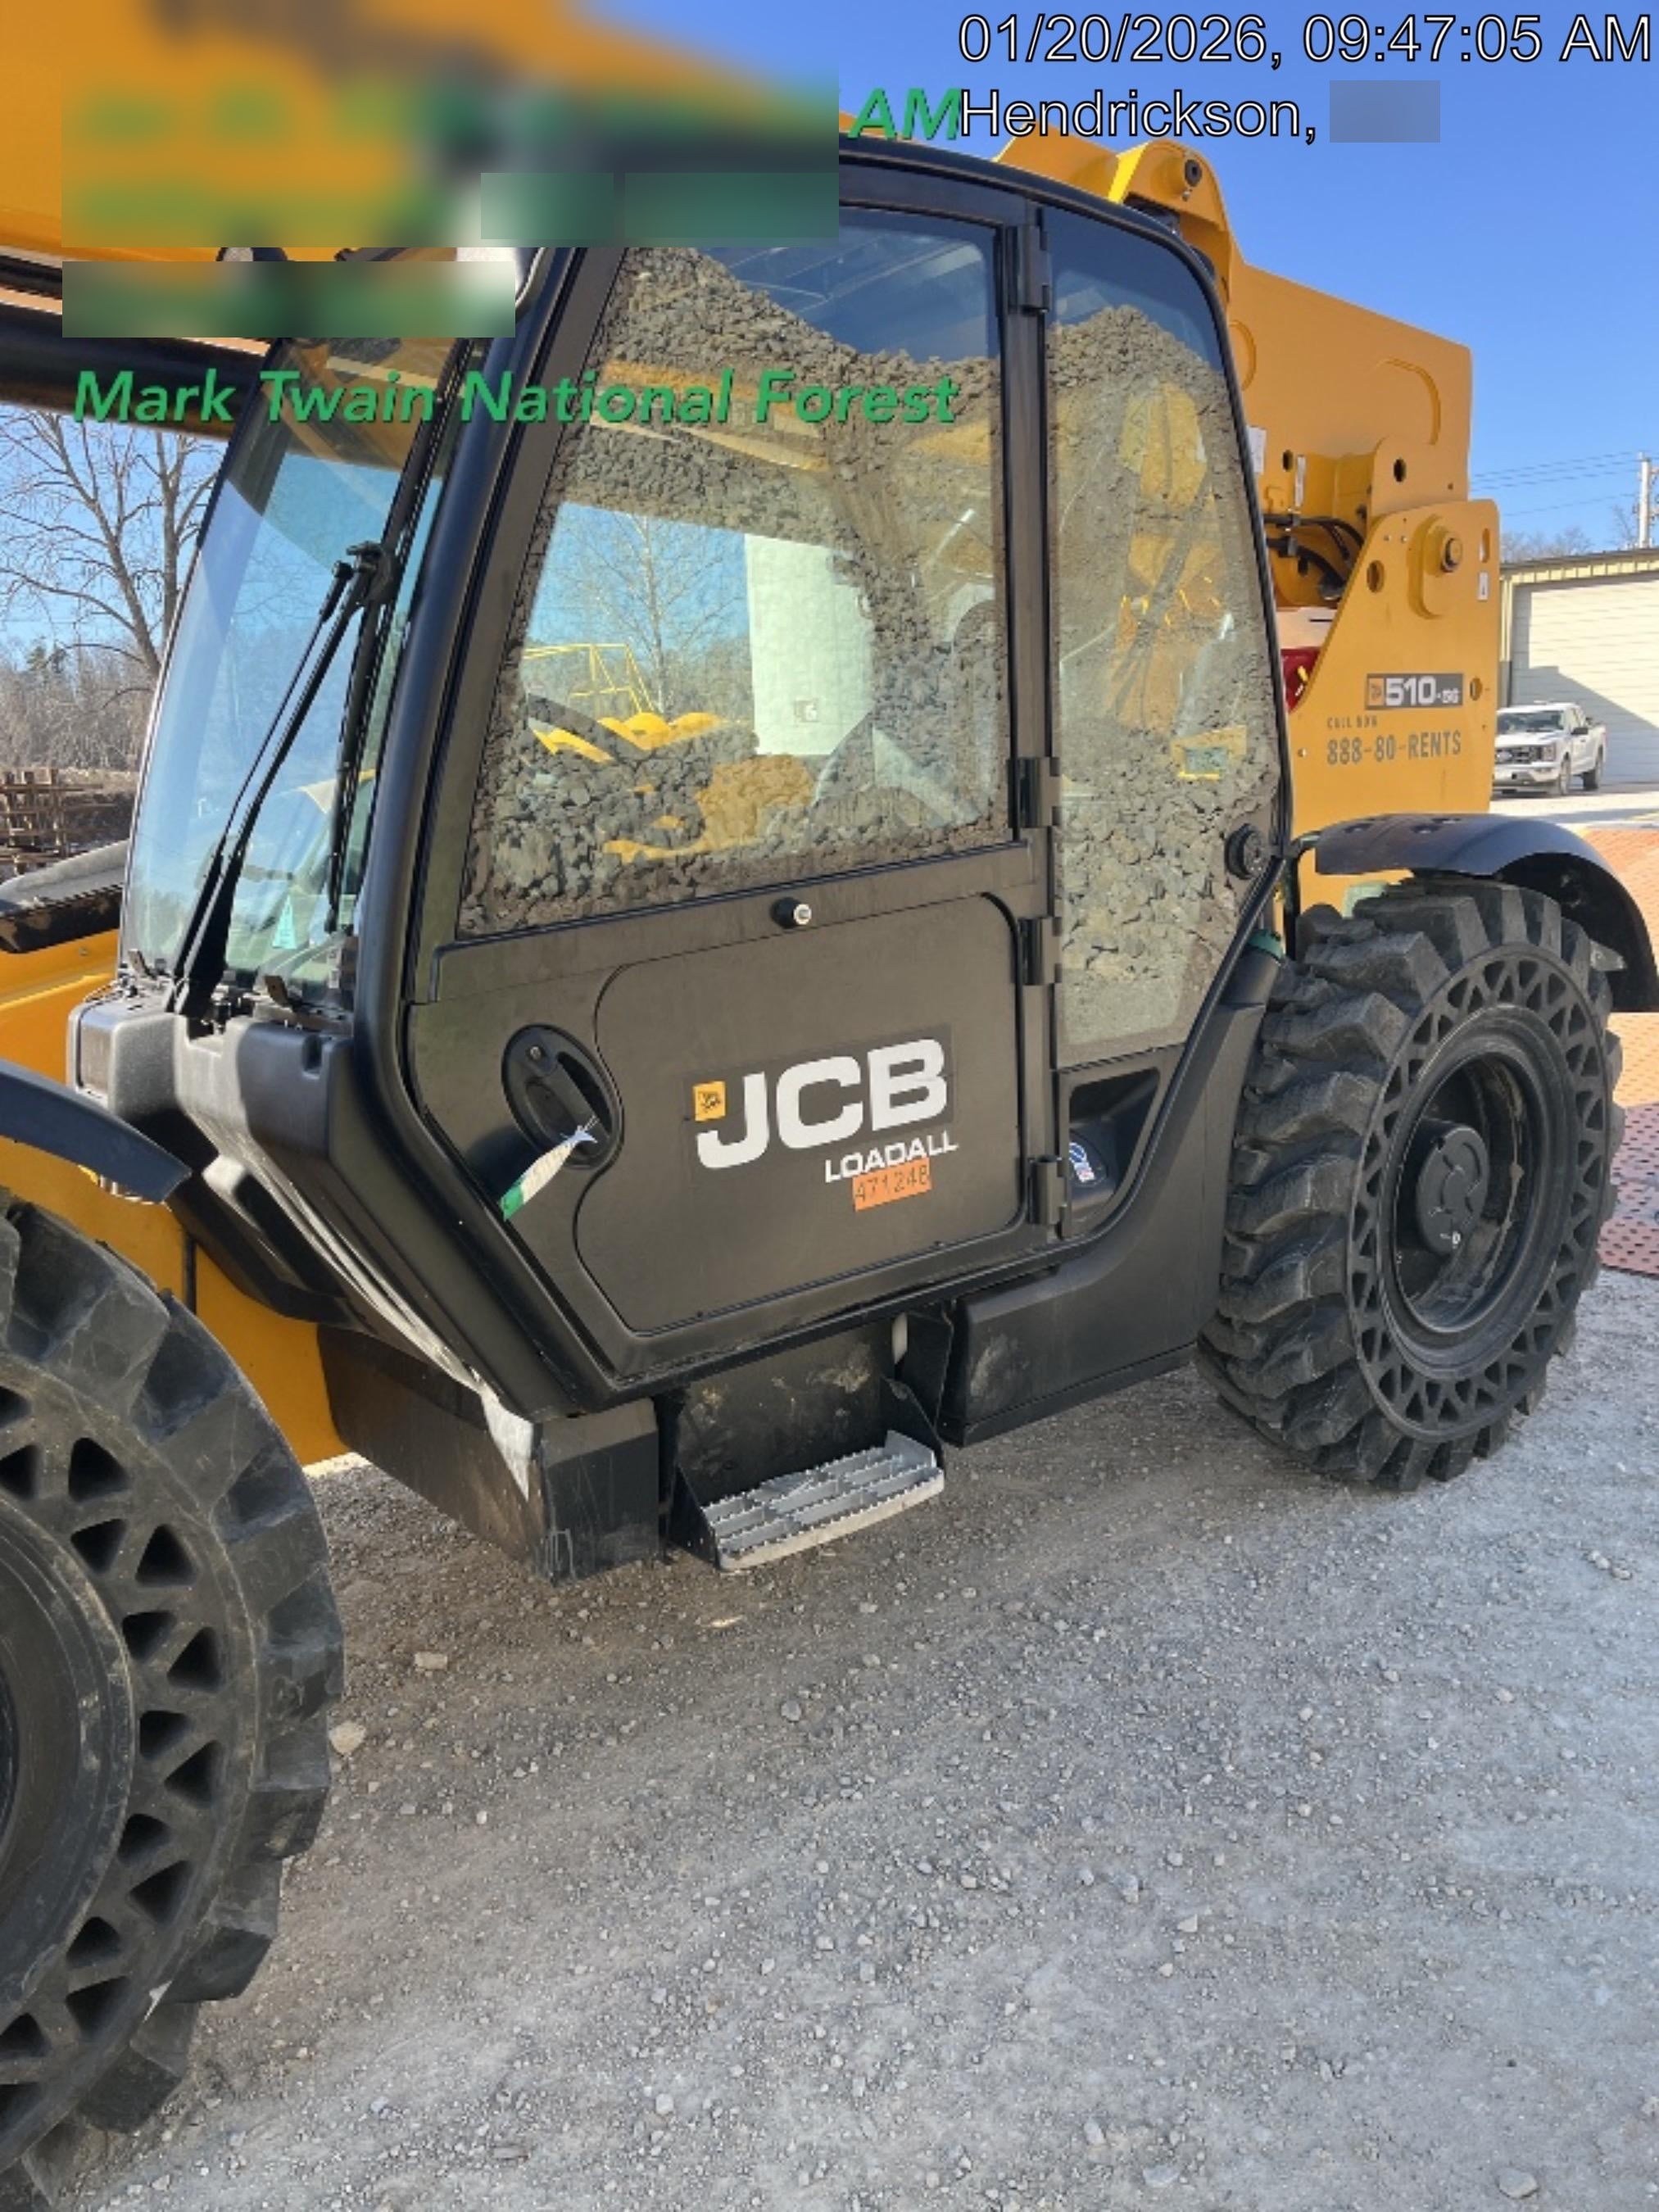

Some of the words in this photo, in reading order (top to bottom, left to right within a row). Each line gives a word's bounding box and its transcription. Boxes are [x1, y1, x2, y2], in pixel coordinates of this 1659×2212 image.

[1327, 729, 1462, 765] 888-80-RENTS
[696, 1039, 947, 1169] JCB
[825, 1131, 959, 1183] LOADALL
